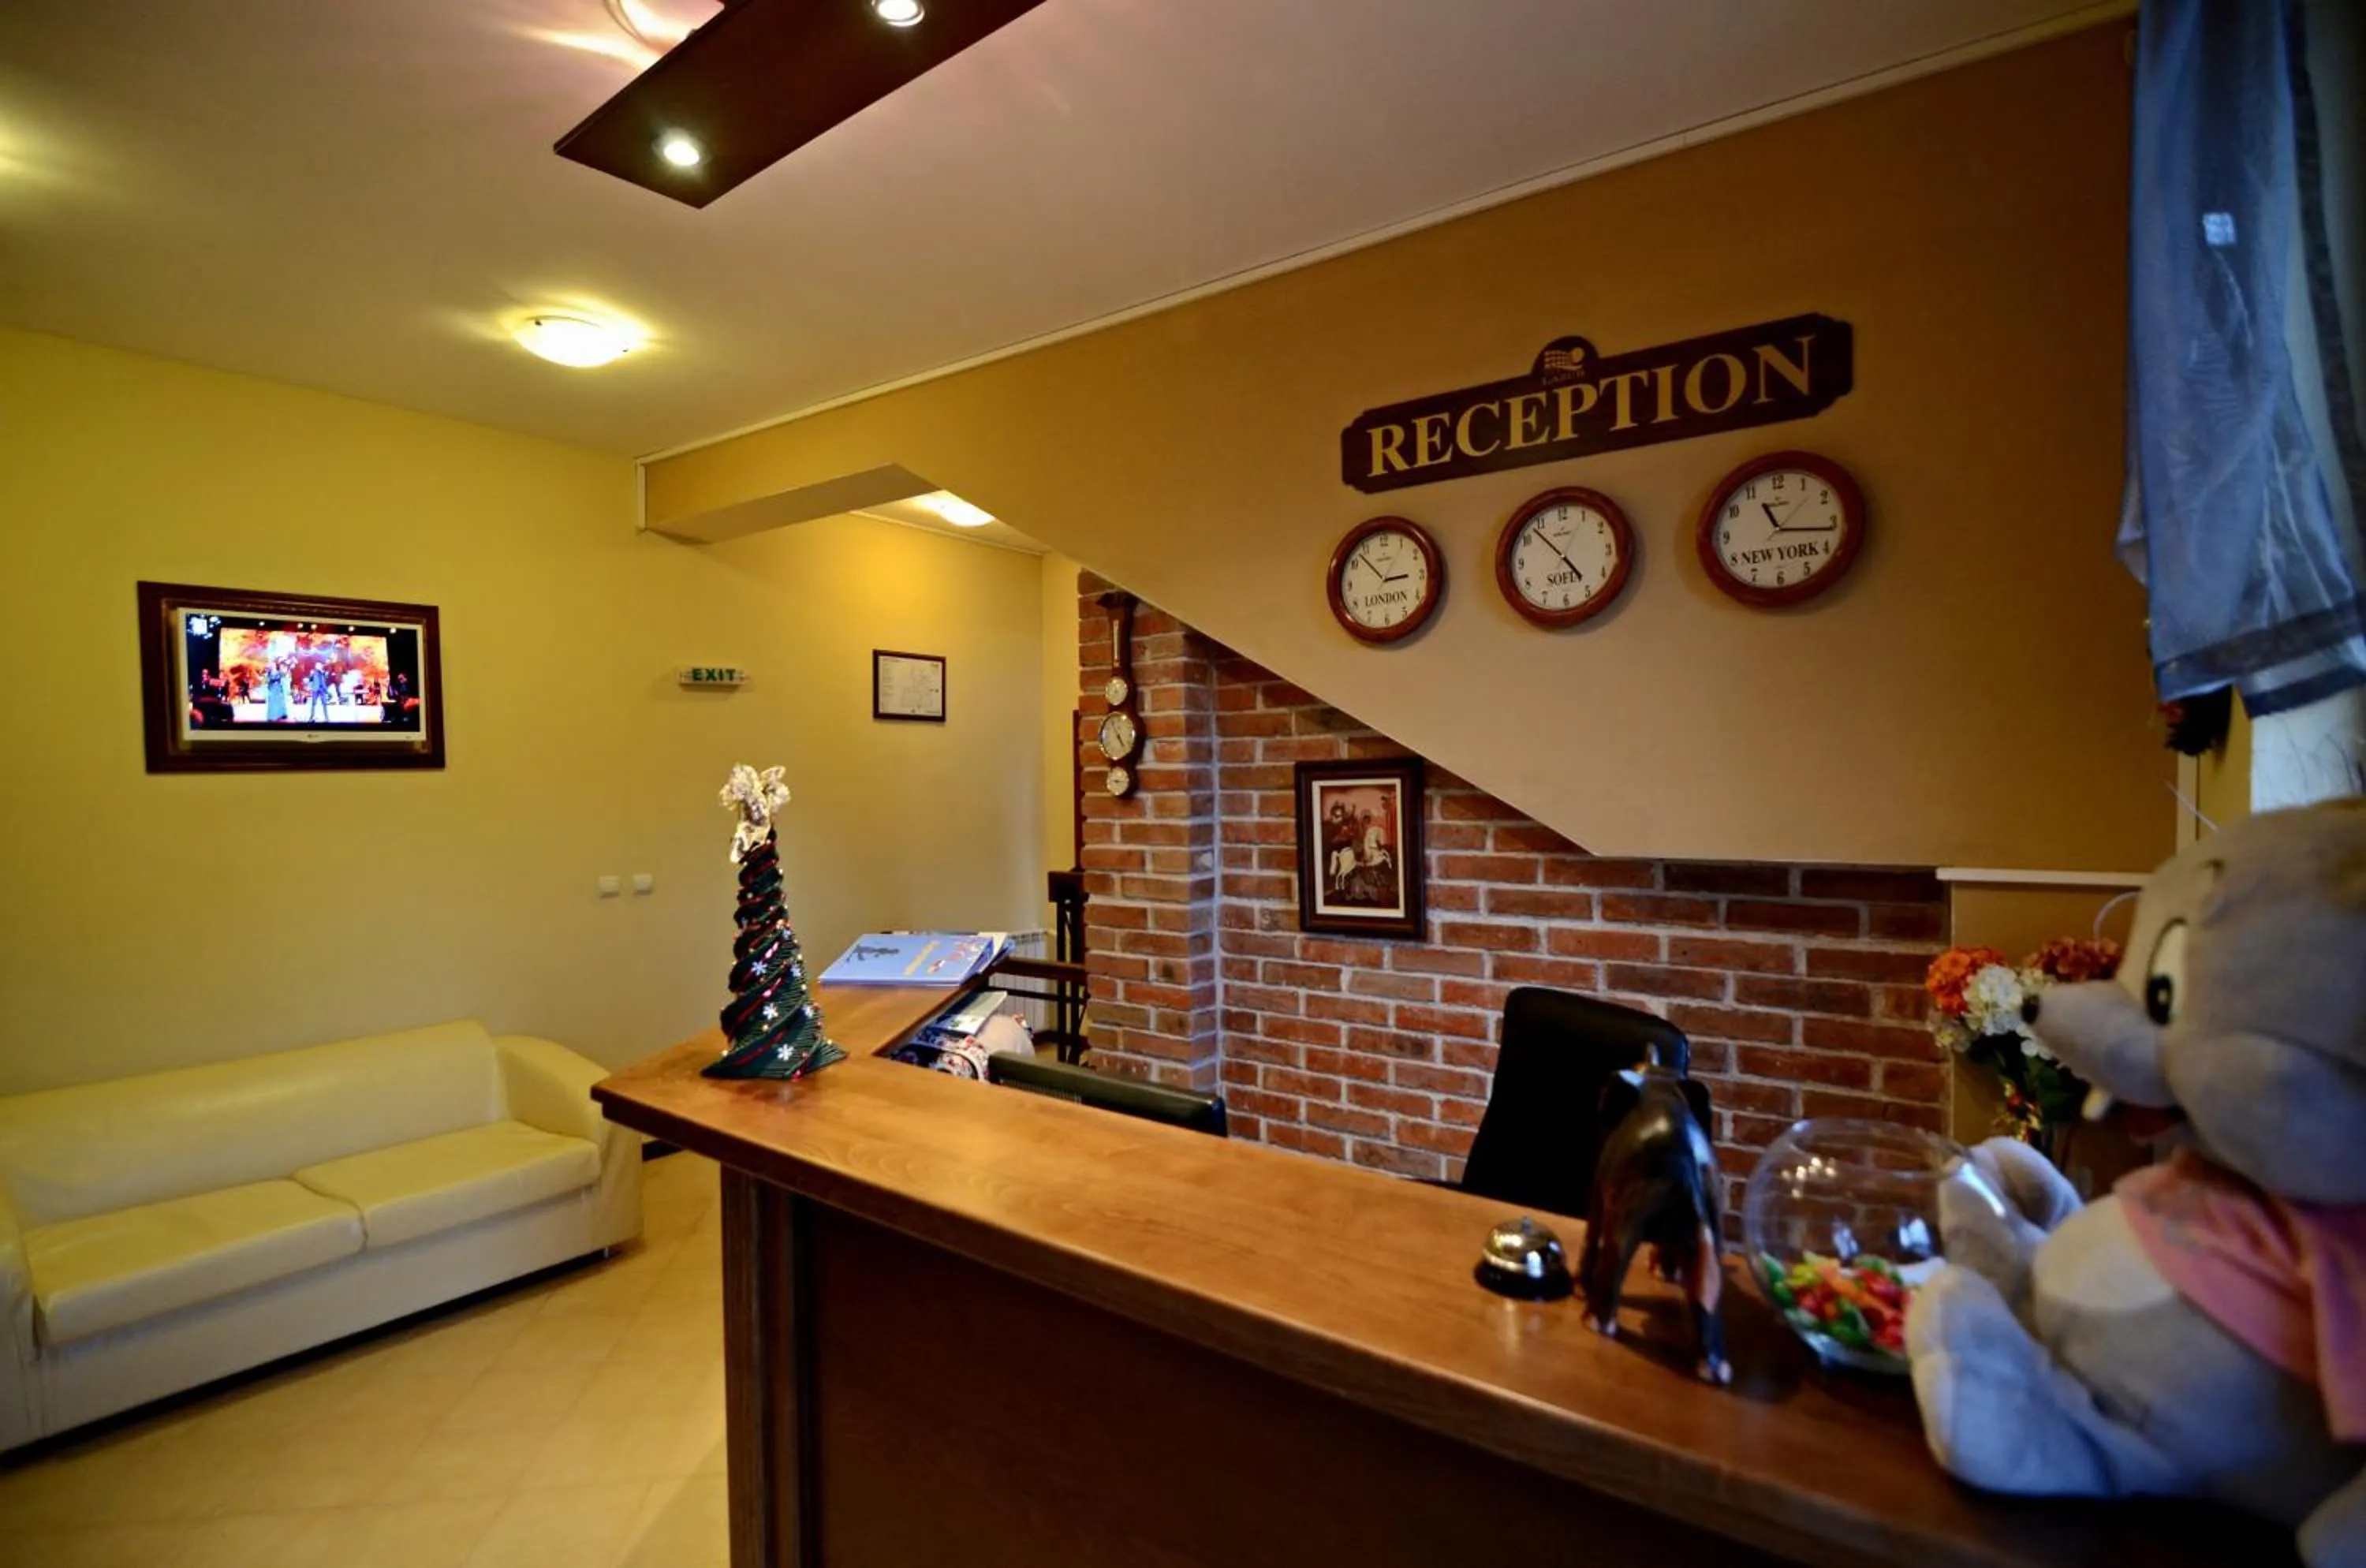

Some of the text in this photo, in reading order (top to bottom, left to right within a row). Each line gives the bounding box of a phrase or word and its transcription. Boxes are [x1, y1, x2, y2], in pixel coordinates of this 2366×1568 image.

[1366, 335, 1816, 477] RECEPTION
[1772, 475, 1785, 490] 12
[1801, 477, 1805, 491] 1
[1746, 486, 1756, 500] 11
[1819, 490, 1828, 505] 2
[1558, 506, 1568, 521] 12
[1581, 510, 1586, 522] 1
[1729, 504, 1740, 518] 10
[1537, 517, 1545, 529] 11
[1598, 521, 1604, 534] 2
[1830, 515, 1838, 530] 3
[1399, 536, 1403, 550] 1
[1722, 531, 1730, 544] 9
[1413, 548, 1418, 561] 2
[1741, 541, 1819, 564] NEW YORK
[1822, 540, 1830, 555] 4
[1518, 558, 1524, 569] 9
[1803, 562, 1811, 577] 5
[1601, 566, 1606, 579] 4
[1777, 570, 1785, 585] 6
[1584, 584, 1591, 598] 5
[1364, 590, 1408, 607] LONDON
[1562, 593, 1570, 607] 6
[1402, 605, 1408, 619] 5
[1384, 614, 1390, 626] 6
[692, 668, 736, 681] EXIT
